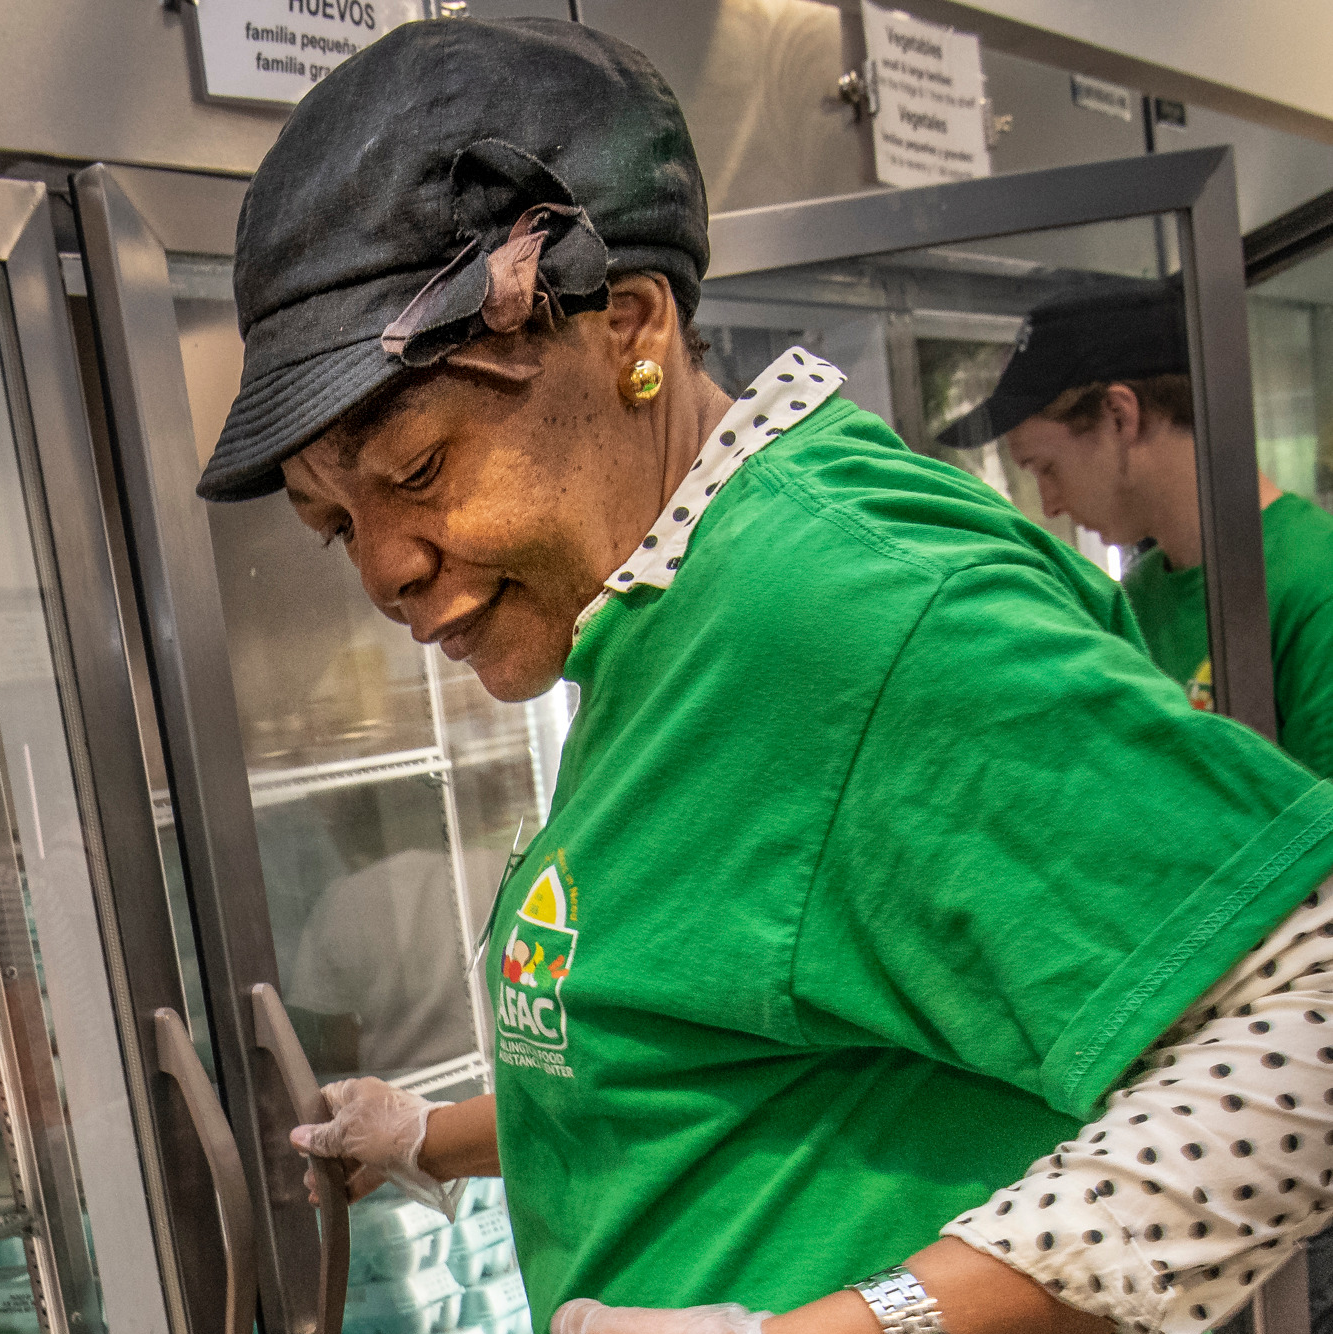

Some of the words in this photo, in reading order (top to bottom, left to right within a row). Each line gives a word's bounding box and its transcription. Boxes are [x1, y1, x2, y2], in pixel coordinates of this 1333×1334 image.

[288, 0, 376, 30] HUEVOS
[245, 21, 296, 45] familia
[255, 52, 306, 77] familia
